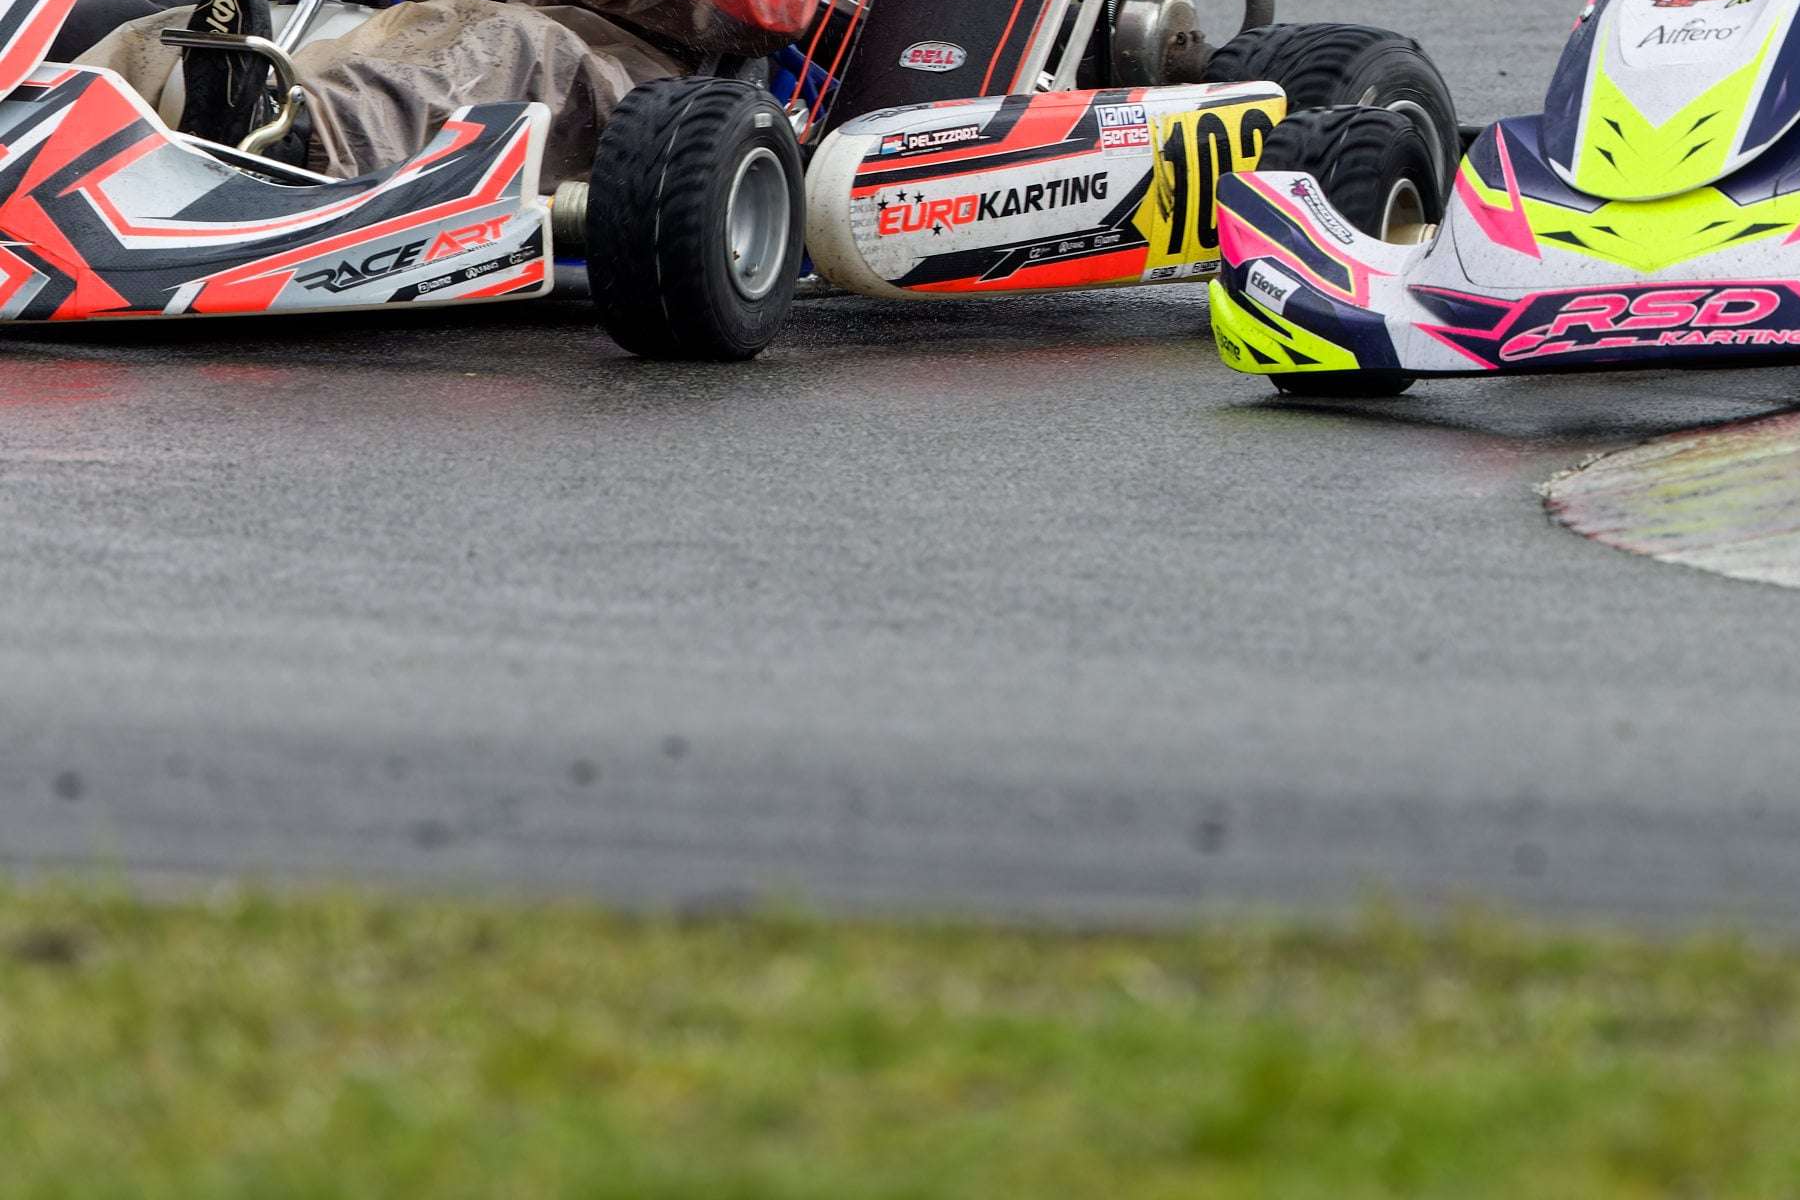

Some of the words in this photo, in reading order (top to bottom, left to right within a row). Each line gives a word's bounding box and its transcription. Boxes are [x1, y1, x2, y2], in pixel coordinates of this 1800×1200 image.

[909, 48, 955, 65] BELL
[909, 126, 980, 150] PELIZZARI
[1104, 127, 1150, 146] series
[1251, 270, 1288, 302] Floyd
[1549, 287, 1781, 338] RSD
